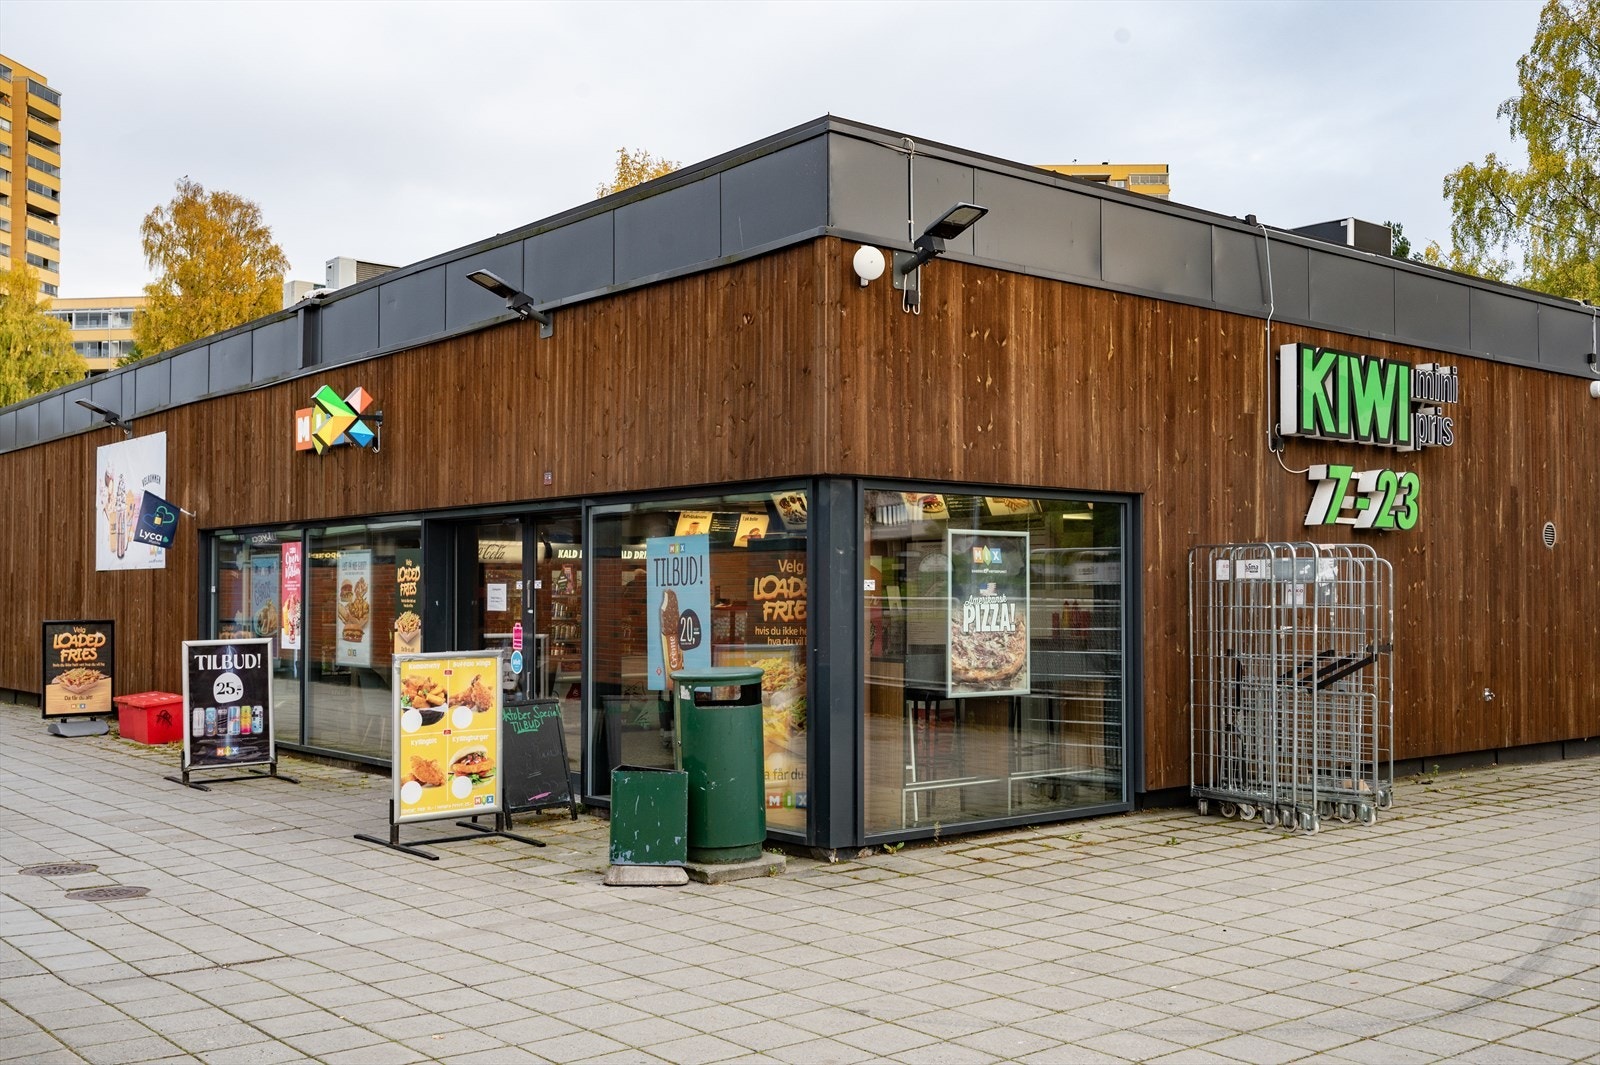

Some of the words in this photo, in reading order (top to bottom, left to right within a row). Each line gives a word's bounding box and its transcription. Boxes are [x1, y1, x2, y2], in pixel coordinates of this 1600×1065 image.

[1414, 363, 1457, 403] mini
[1299, 344, 1410, 446] KIWI
[1413, 407, 1453, 450] pris
[1318, 464, 1420, 530] 7-23
[139, 529, 163, 542] Lyca
[557, 549, 577, 559] KALD
[669, 543, 685, 554] MIX
[974, 549, 1001, 562] MIX
[396, 565, 421, 583] LOADED
[653, 555, 703, 587] TILBUD!
[778, 559, 804, 575] Velg
[400, 581, 417, 597] FRIES
[964, 594, 1008, 606] Amerikansk
[963, 603, 1016, 632] PIZZA!
[680, 616, 700, 645] 20,-
[755, 626, 769, 635] hvis
[770, 626, 780, 635] du
[782, 626, 798, 635] ikke
[53, 631, 106, 649] LOADED
[767, 636, 780, 645] hva
[782, 636, 792, 645] du
[60, 647, 98, 662] FRIES
[194, 653, 262, 670] TILBUD!
[216, 681, 242, 696] 25,-
[510, 718, 541, 732] TILBUD
[216, 745, 239, 757] MIX
[772, 767, 789, 780] får
[790, 767, 804, 780] du
[474, 795, 494, 805] MIX
